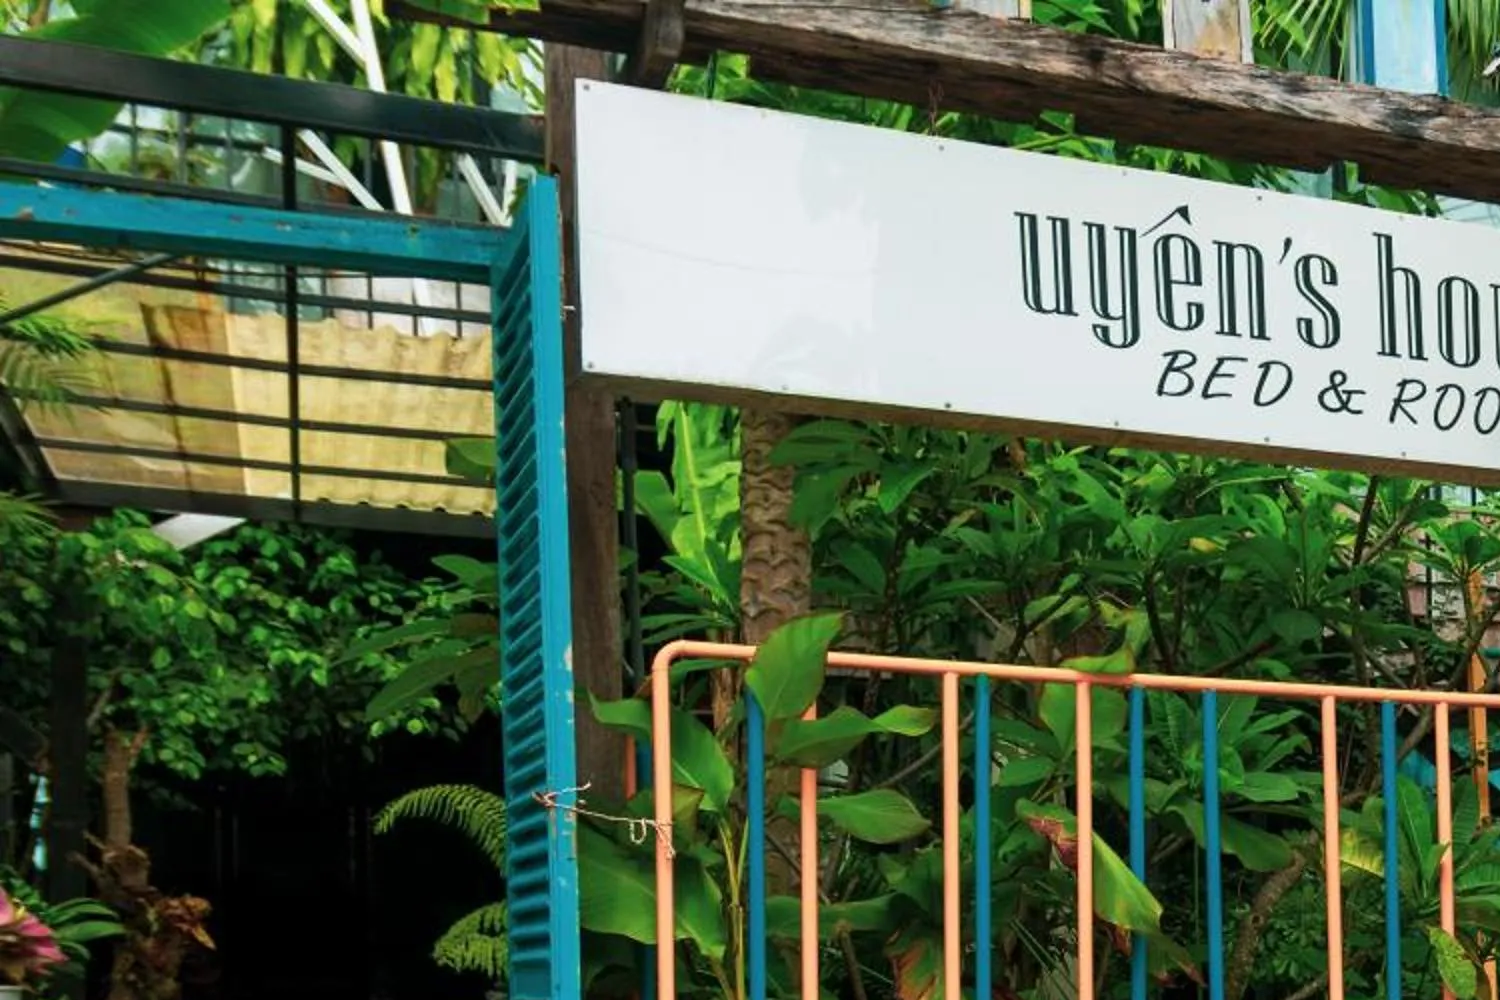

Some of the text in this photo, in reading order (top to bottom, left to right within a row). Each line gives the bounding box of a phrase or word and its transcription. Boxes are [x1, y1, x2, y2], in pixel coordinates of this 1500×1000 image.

[1013, 204, 1341, 350] uyên's
[1155, 348, 1294, 408] BED
[1316, 368, 1366, 416] &
